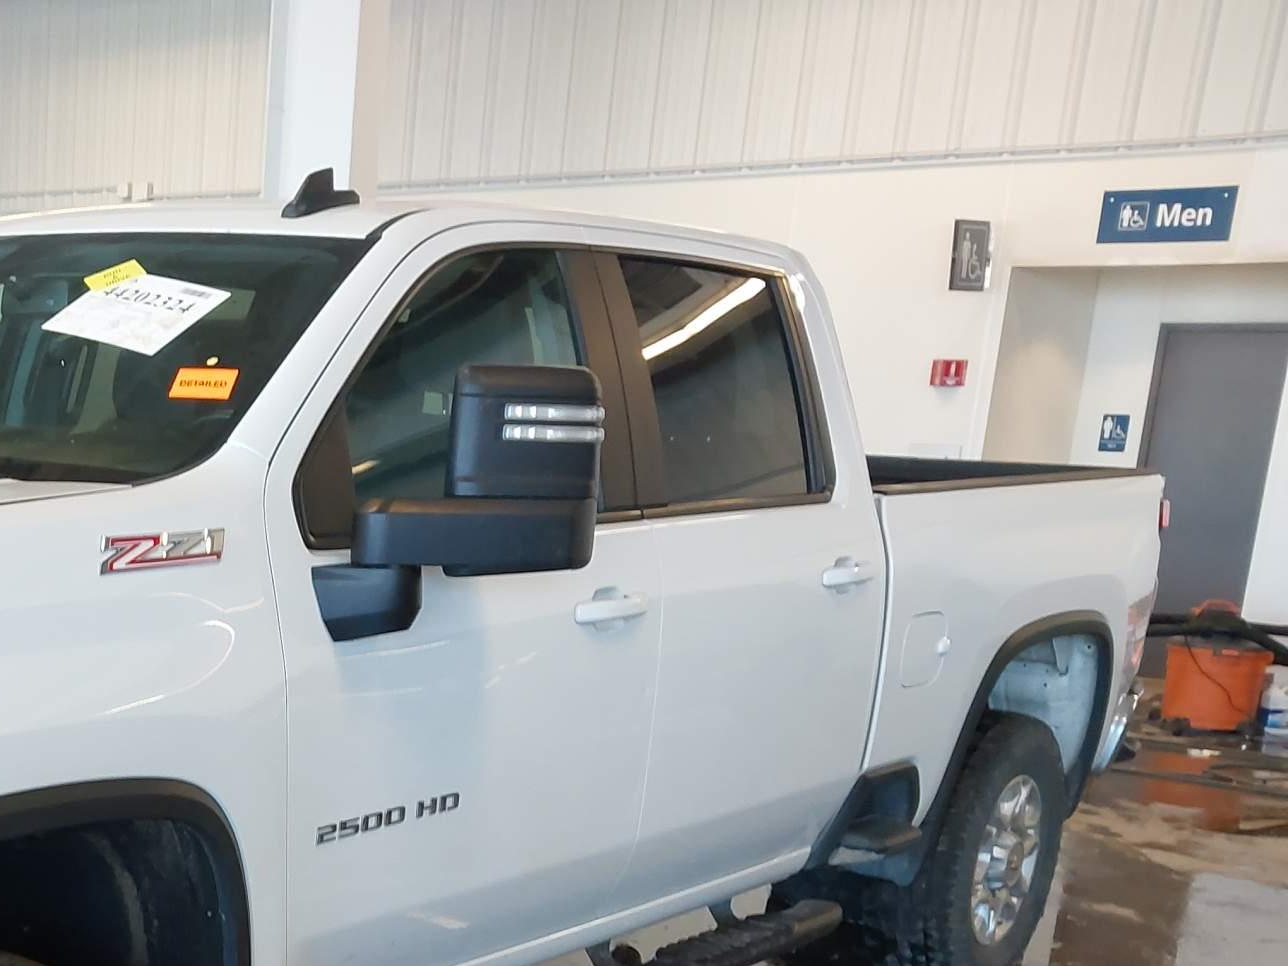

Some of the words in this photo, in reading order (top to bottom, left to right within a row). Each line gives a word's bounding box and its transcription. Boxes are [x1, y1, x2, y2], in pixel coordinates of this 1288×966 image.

[1155, 202, 1213, 228] Men
[103, 286, 197, 314] 44202324
[179, 379, 228, 388] DETAILED
[316, 805, 406, 846] 2500
[415, 792, 460, 819] HD
